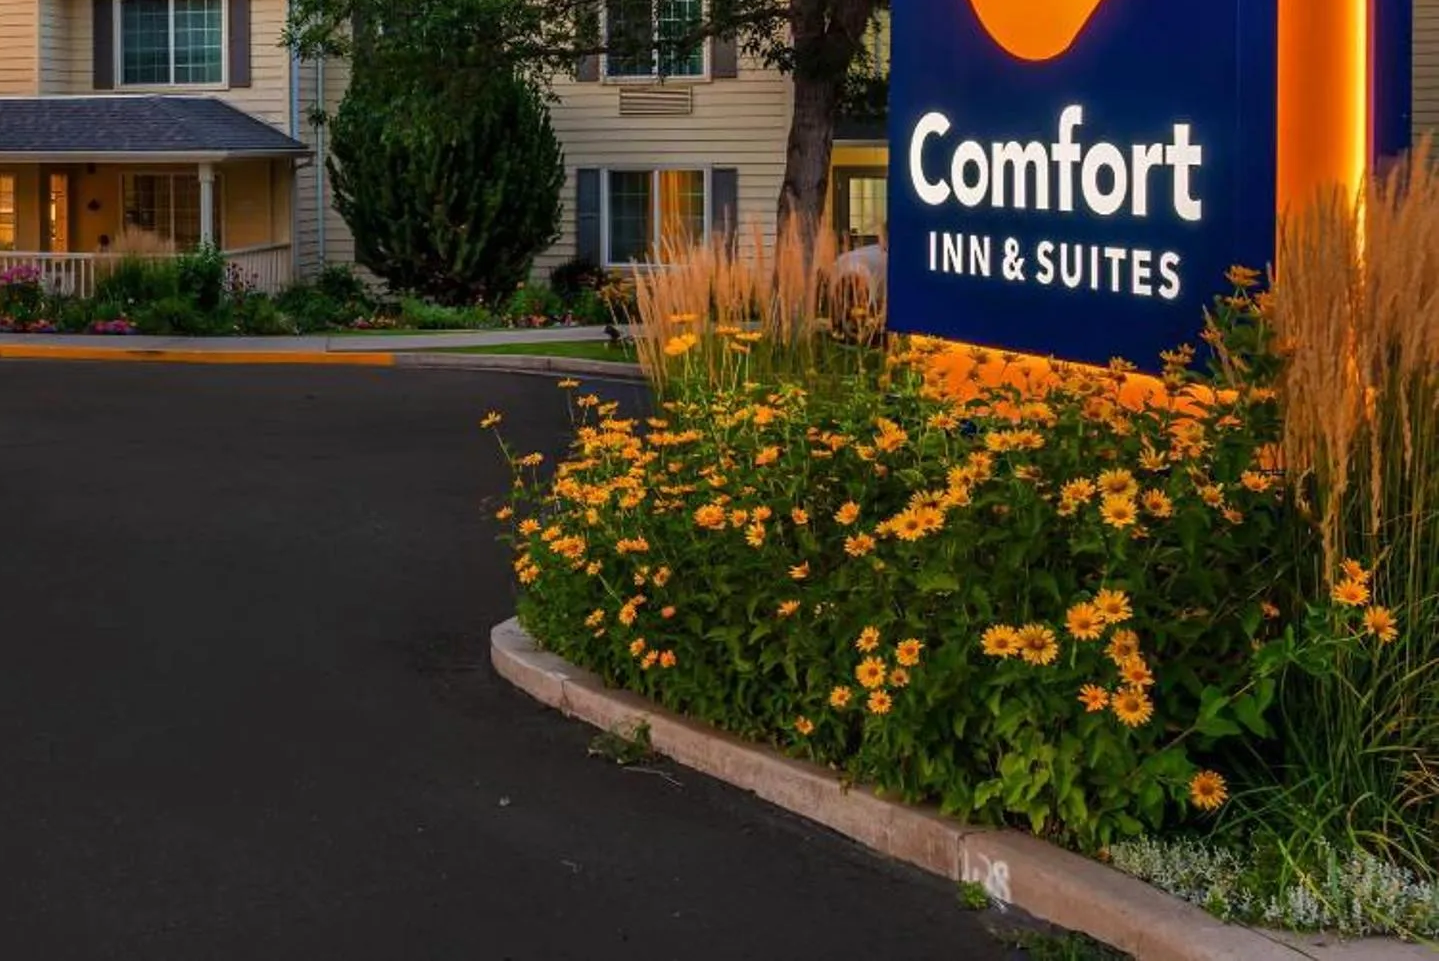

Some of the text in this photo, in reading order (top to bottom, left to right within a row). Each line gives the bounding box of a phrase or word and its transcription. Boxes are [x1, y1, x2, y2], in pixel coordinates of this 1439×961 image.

[910, 104, 1202, 221] Comfort
[929, 231, 1181, 300] INN & SUITES
